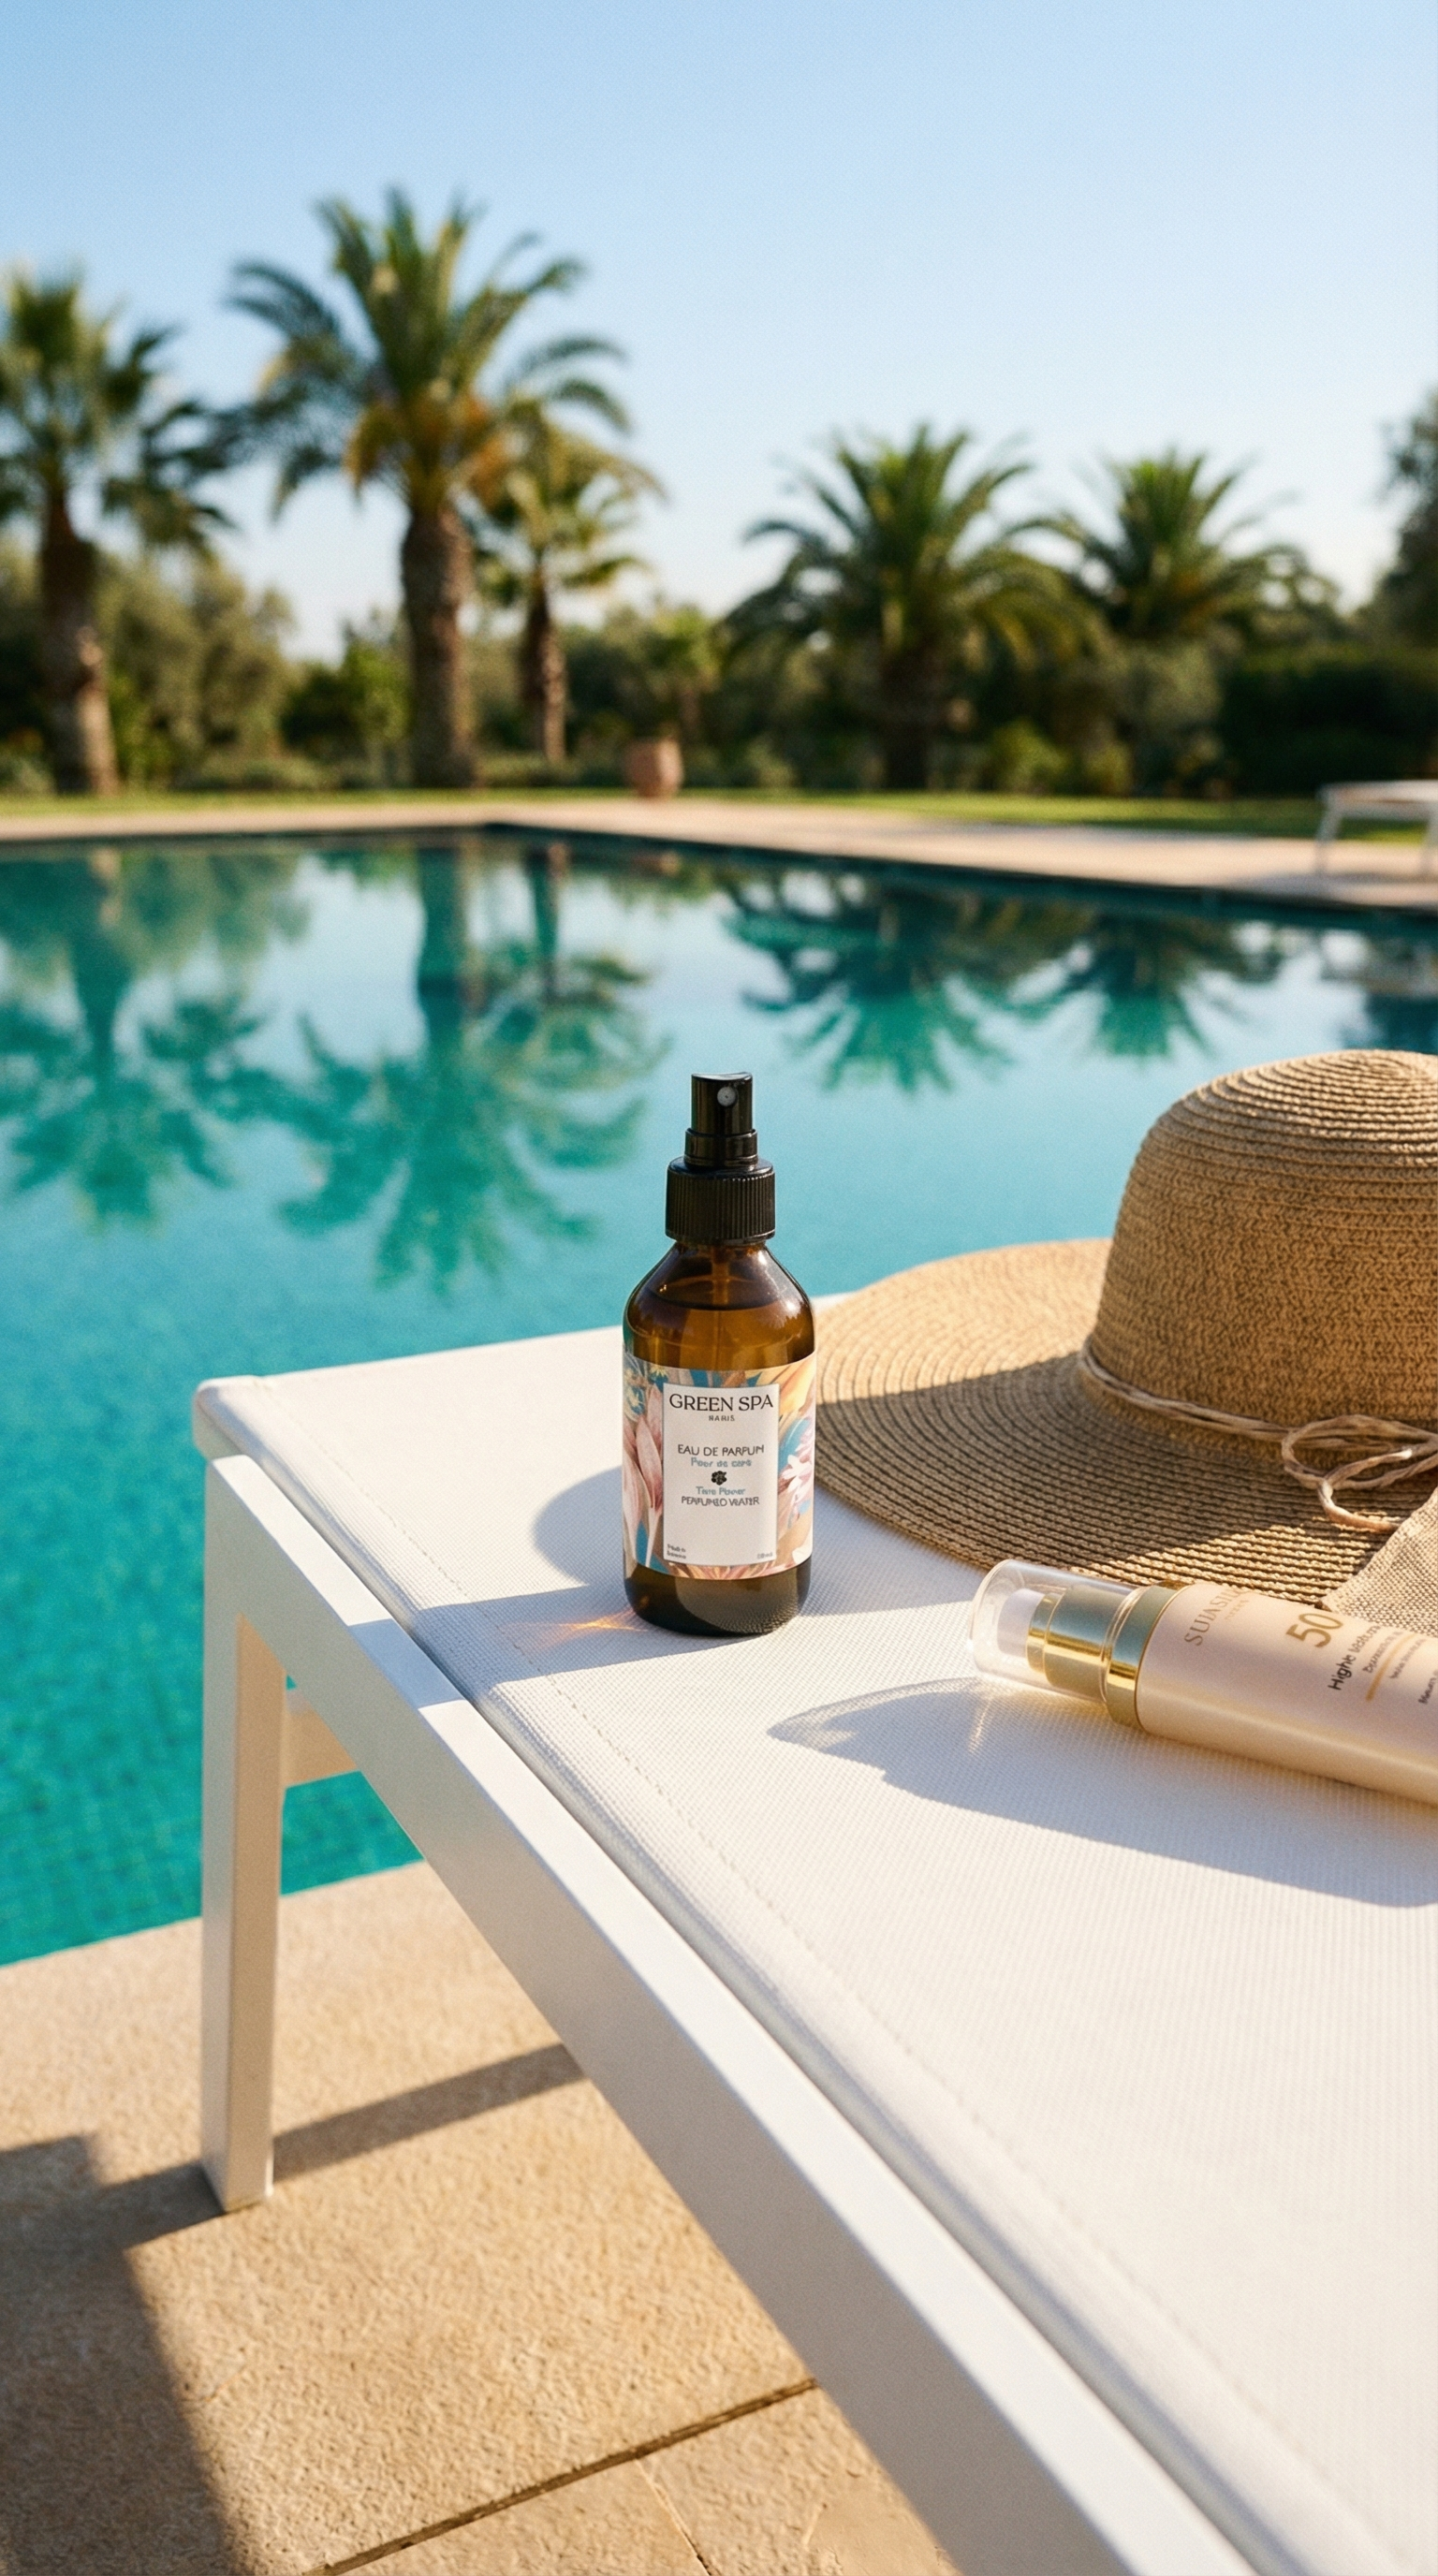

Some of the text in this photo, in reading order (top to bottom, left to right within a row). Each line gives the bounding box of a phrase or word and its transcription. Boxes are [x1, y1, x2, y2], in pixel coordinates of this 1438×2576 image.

[669, 1393, 774, 1412] GREEN SPA
[677, 1443, 700, 1456] EAU
[703, 1446, 719, 1456] DE
[1285, 1612, 1344, 1648] 50
